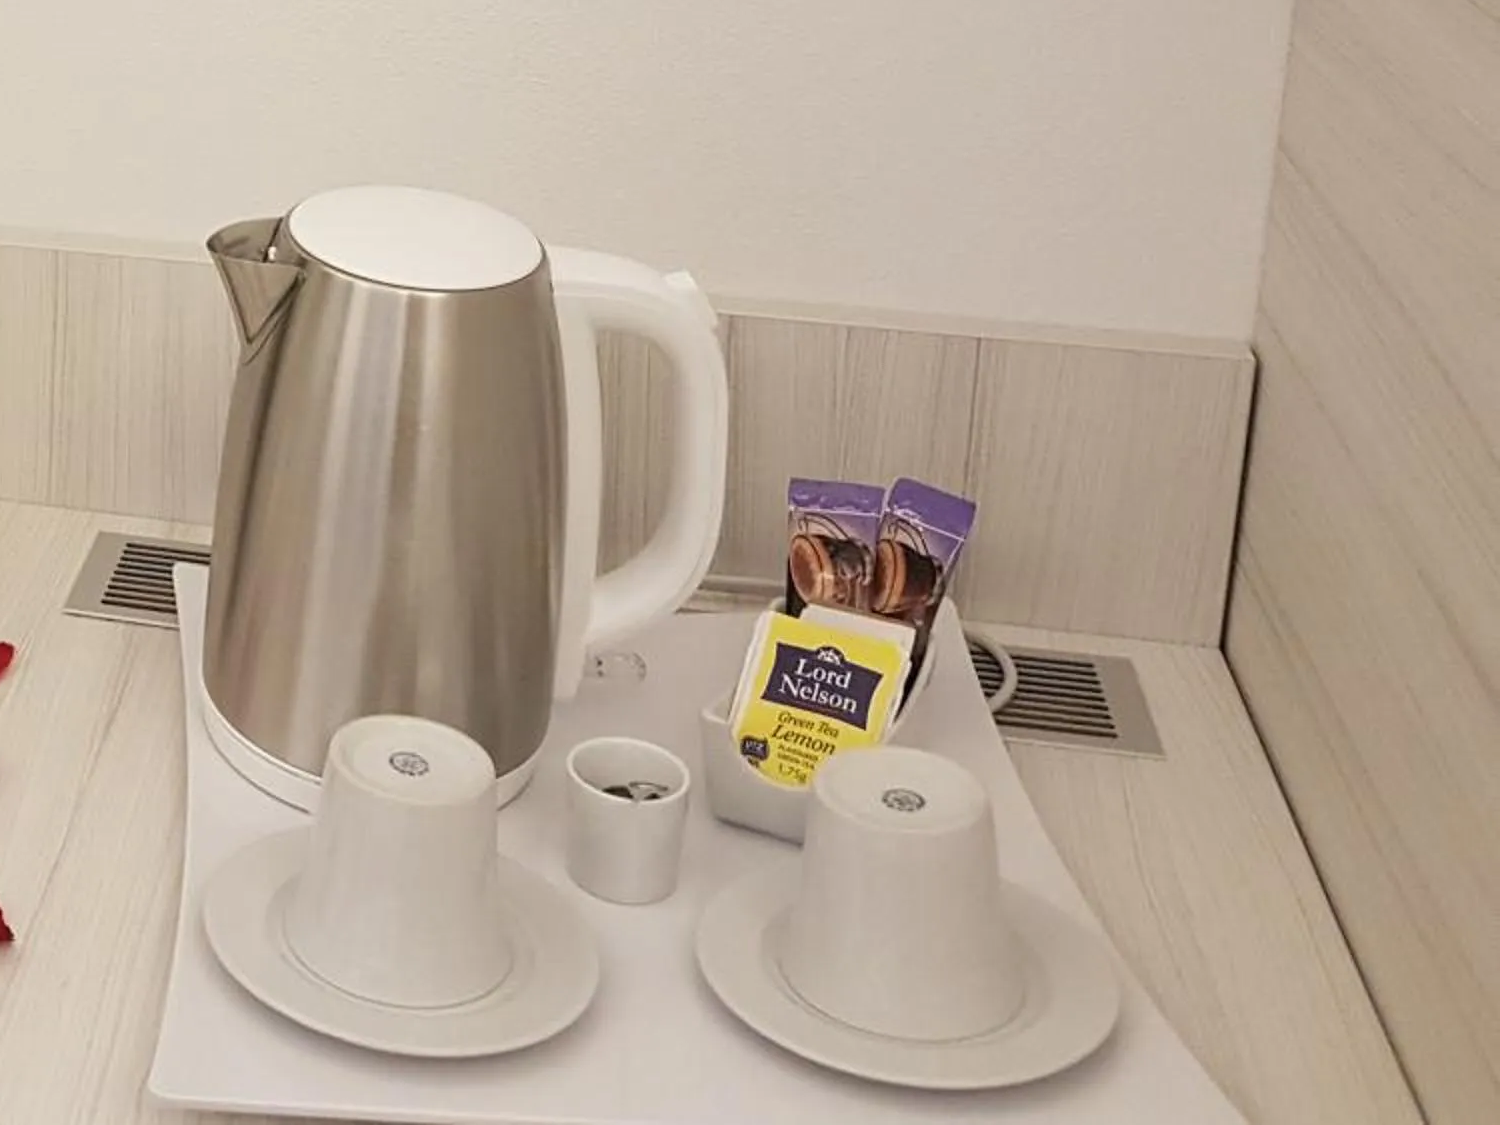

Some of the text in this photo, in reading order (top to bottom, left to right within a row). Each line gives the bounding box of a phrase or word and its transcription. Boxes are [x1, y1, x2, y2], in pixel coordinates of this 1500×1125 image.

[795, 658, 853, 690] Lord
[778, 673, 858, 714] Nelson
[771, 724, 837, 756] Lemon
[778, 711, 840, 739] Green Tea
